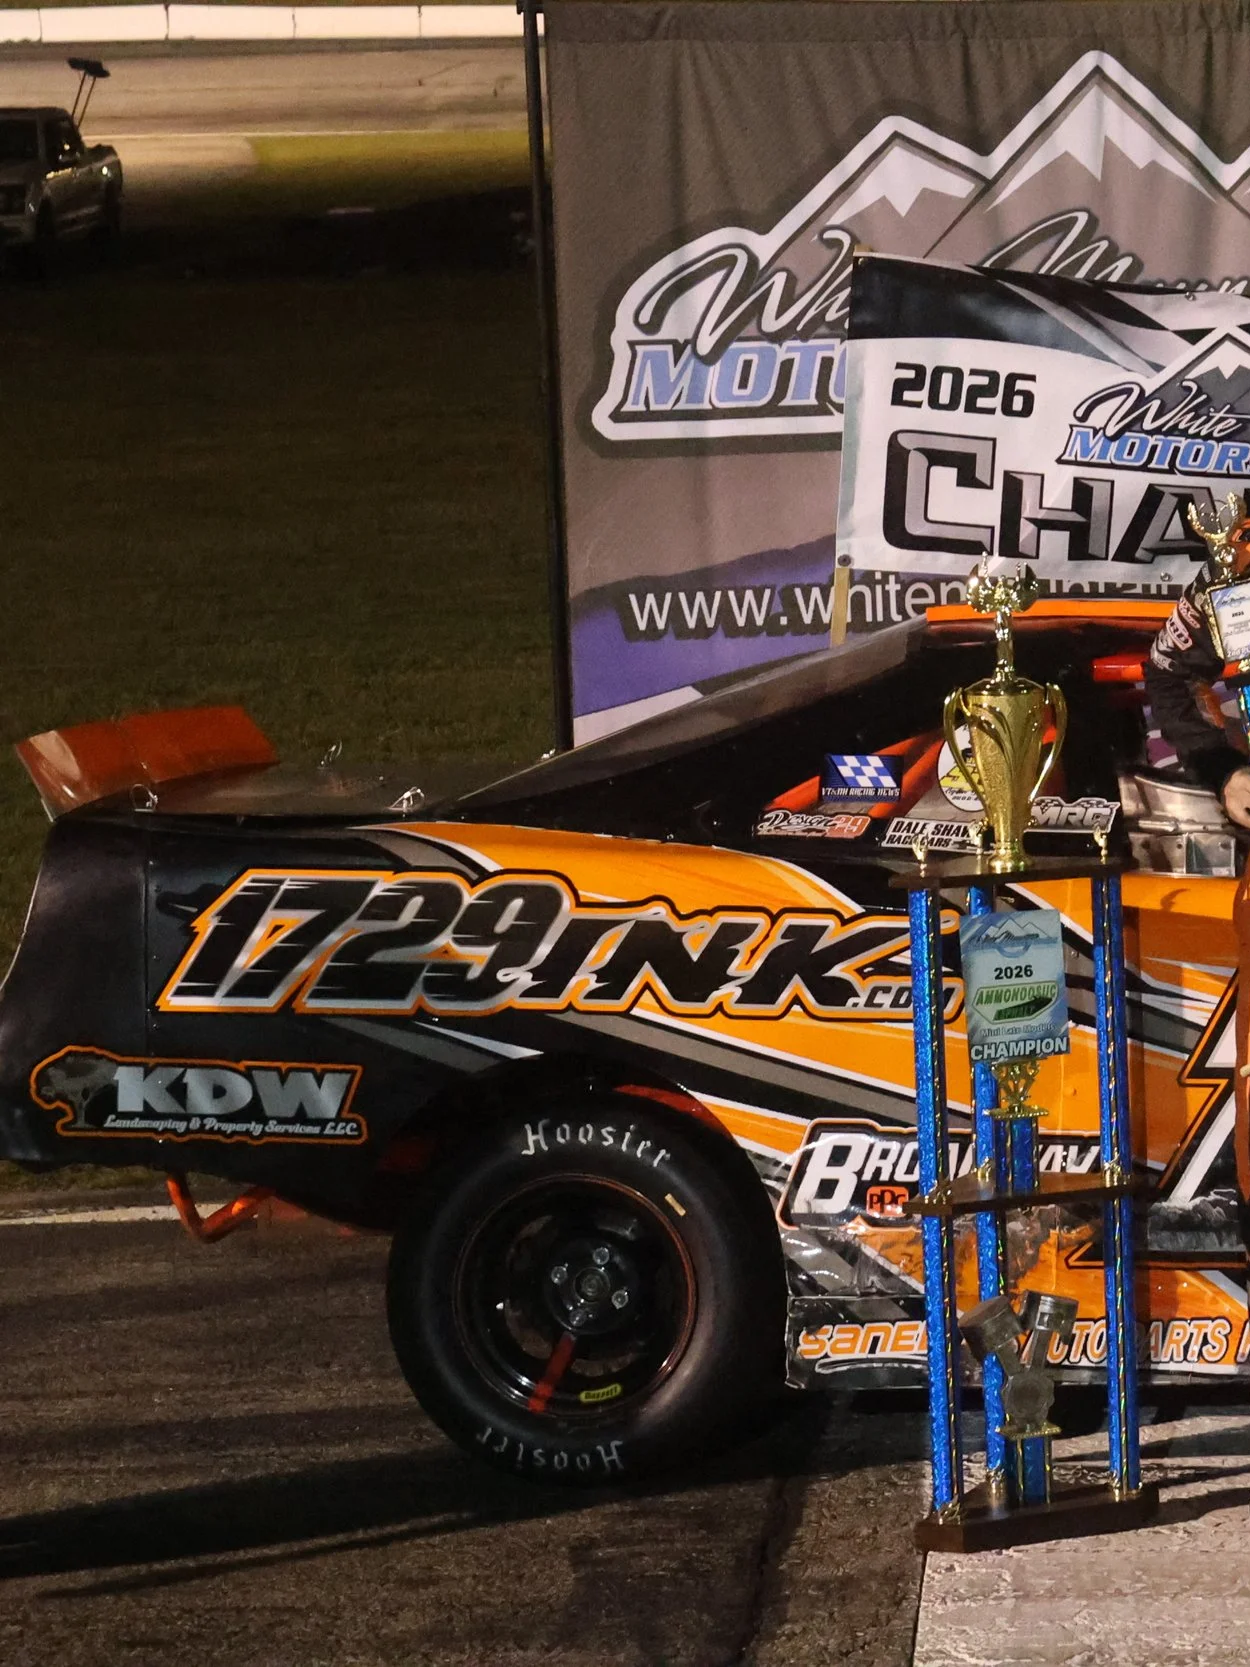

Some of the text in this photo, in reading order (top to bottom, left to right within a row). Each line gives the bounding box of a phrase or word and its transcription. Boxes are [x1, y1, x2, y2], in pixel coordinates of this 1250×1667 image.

[891, 362, 1036, 418] 2026
[876, 787, 901, 797] NEWS
[758, 810, 872, 839] Design 29
[891, 820, 929, 835] DALE
[994, 964, 1034, 981] 2026
[970, 1036, 1068, 1061] CHAMPION
[113, 1065, 351, 1119] KDW
[104, 1114, 186, 1133] Landscaping
[189, 1116, 200, 1130] &
[202, 1117, 263, 1136] Property
[264, 1121, 320, 1134] Services
[521, 1118, 671, 1168] Hoosier
